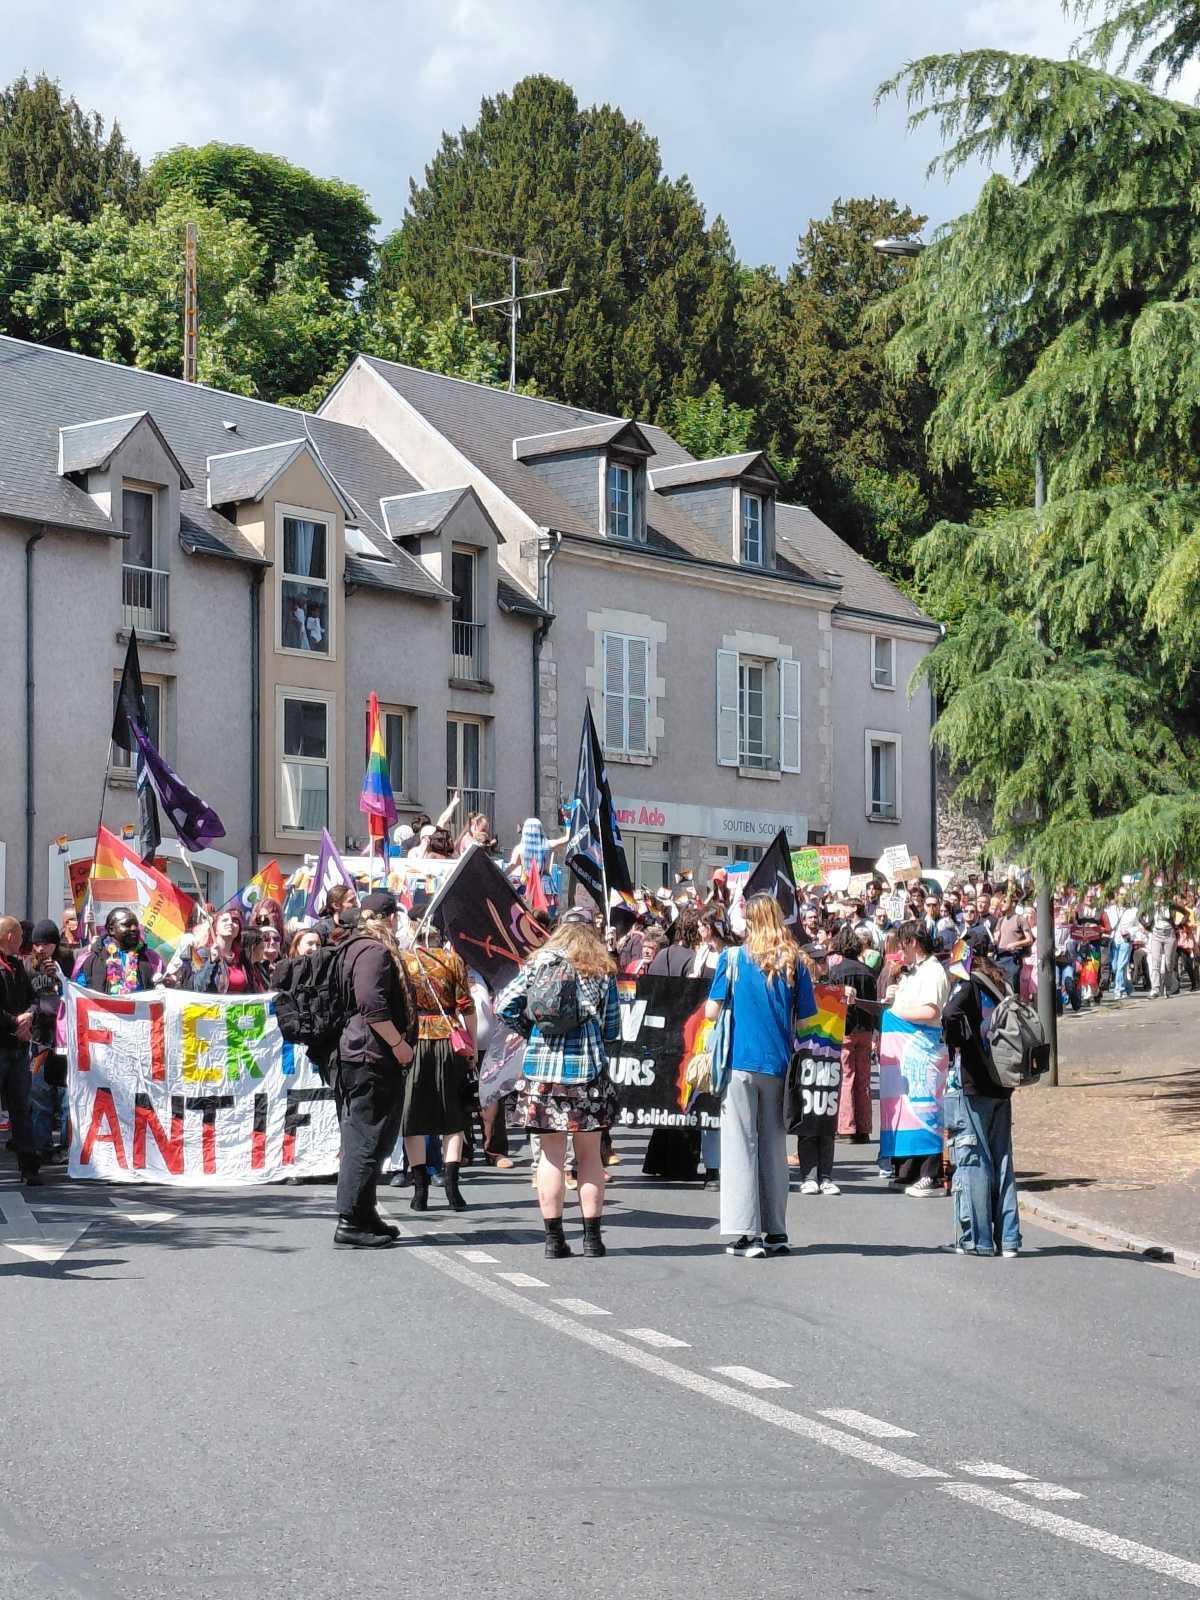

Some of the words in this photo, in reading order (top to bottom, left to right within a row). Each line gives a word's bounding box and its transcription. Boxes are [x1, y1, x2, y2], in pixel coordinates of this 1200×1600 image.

[616, 808, 635, 824] urs
[638, 806, 666, 826] Ado
[722, 819, 756, 834] SOUTIEN
[758, 822, 793, 837] SCOLARE
[615, 1000, 665, 1041] V-
[76, 998, 318, 1083] FIER
[607, 1056, 656, 1086] URS
[800, 1057, 841, 1087] ONS
[802, 1088, 839, 1116] OUS
[80, 1087, 337, 1175] ANTIF
[700, 1111, 721, 1128] Tra
